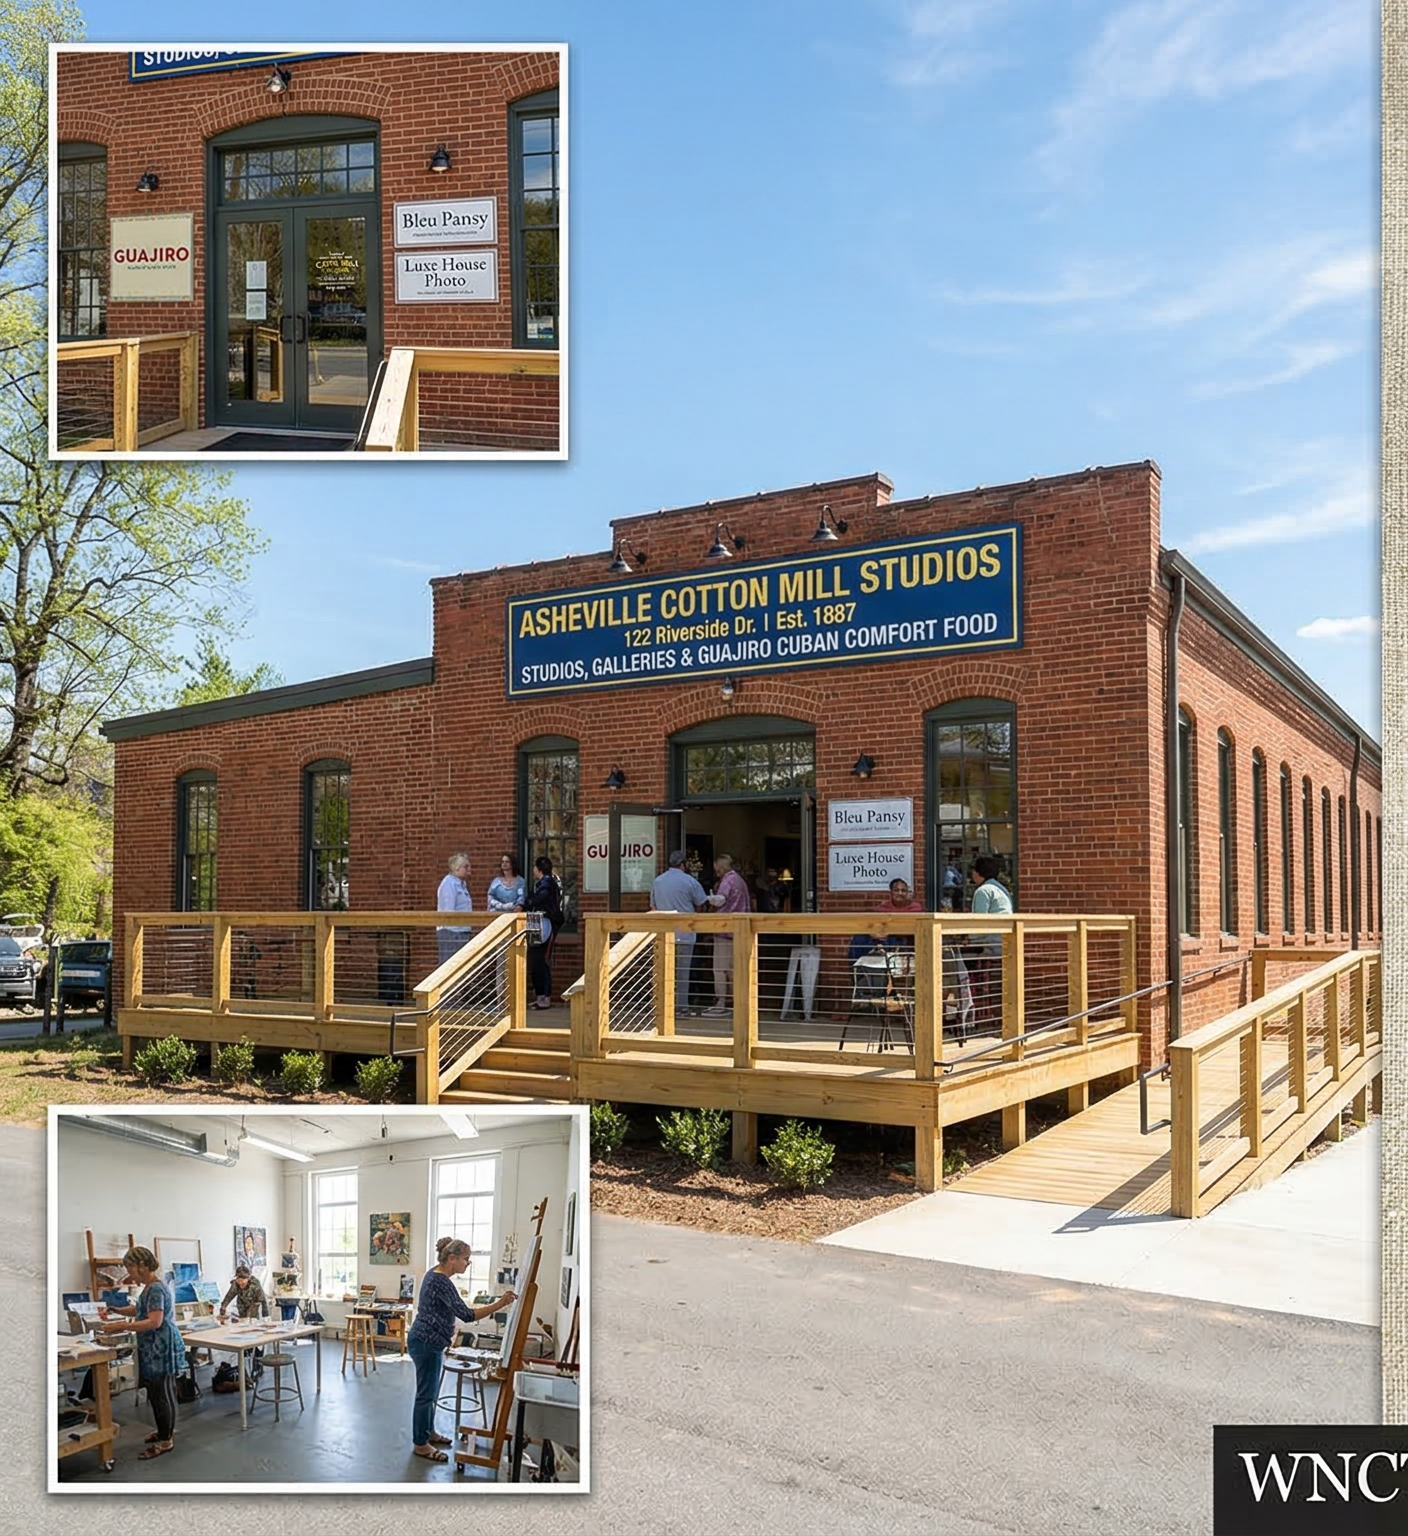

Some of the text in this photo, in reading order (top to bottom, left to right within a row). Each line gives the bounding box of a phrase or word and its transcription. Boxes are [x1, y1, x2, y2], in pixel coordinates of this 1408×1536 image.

[402, 211, 489, 230] Bleu Pansy
[114, 247, 189, 263] GUAJIRO
[404, 258, 487, 272] Luxe House
[425, 273, 466, 287] Photo
[519, 543, 1001, 638] ASHEVILLE COTTON MILL STUDIOS
[624, 628, 651, 648] 122
[656, 619, 729, 644] Riverside
[735, 616, 756, 635] Dr.
[776, 609, 807, 630] Est.
[813, 602, 857, 626] 1887
[521, 612, 998, 684] STUDIOS, GALLERIES & GUAJIRO CUBAN COMFORT FOOD
[834, 810, 906, 826] Bleu Pansy
[587, 844, 654, 859] GUJIRO
[835, 851, 905, 864] Luxe House
[852, 865, 888, 878] Photo
